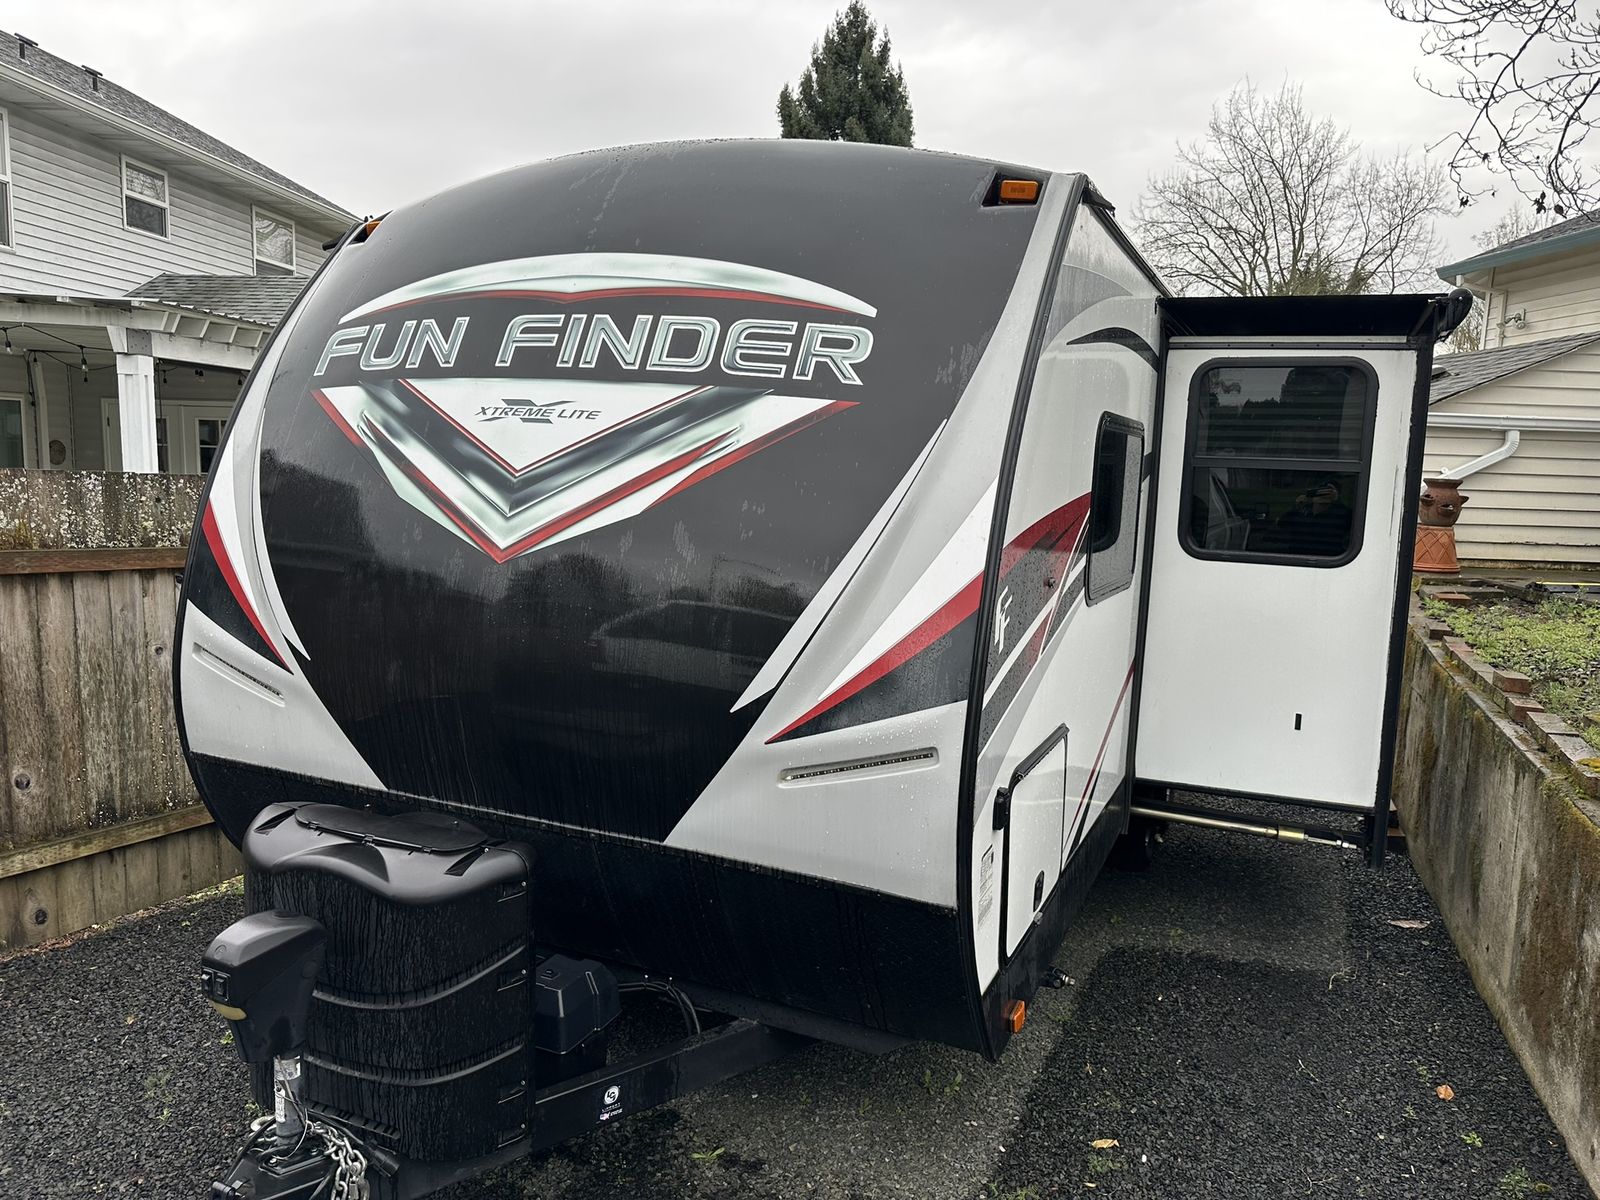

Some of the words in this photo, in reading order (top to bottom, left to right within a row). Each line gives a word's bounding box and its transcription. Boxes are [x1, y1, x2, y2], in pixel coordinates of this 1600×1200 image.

[313, 316, 470, 376] FUN
[495, 313, 874, 385] FINDER
[475, 406, 556, 418] XTREME
[557, 409, 602, 420] LITE
